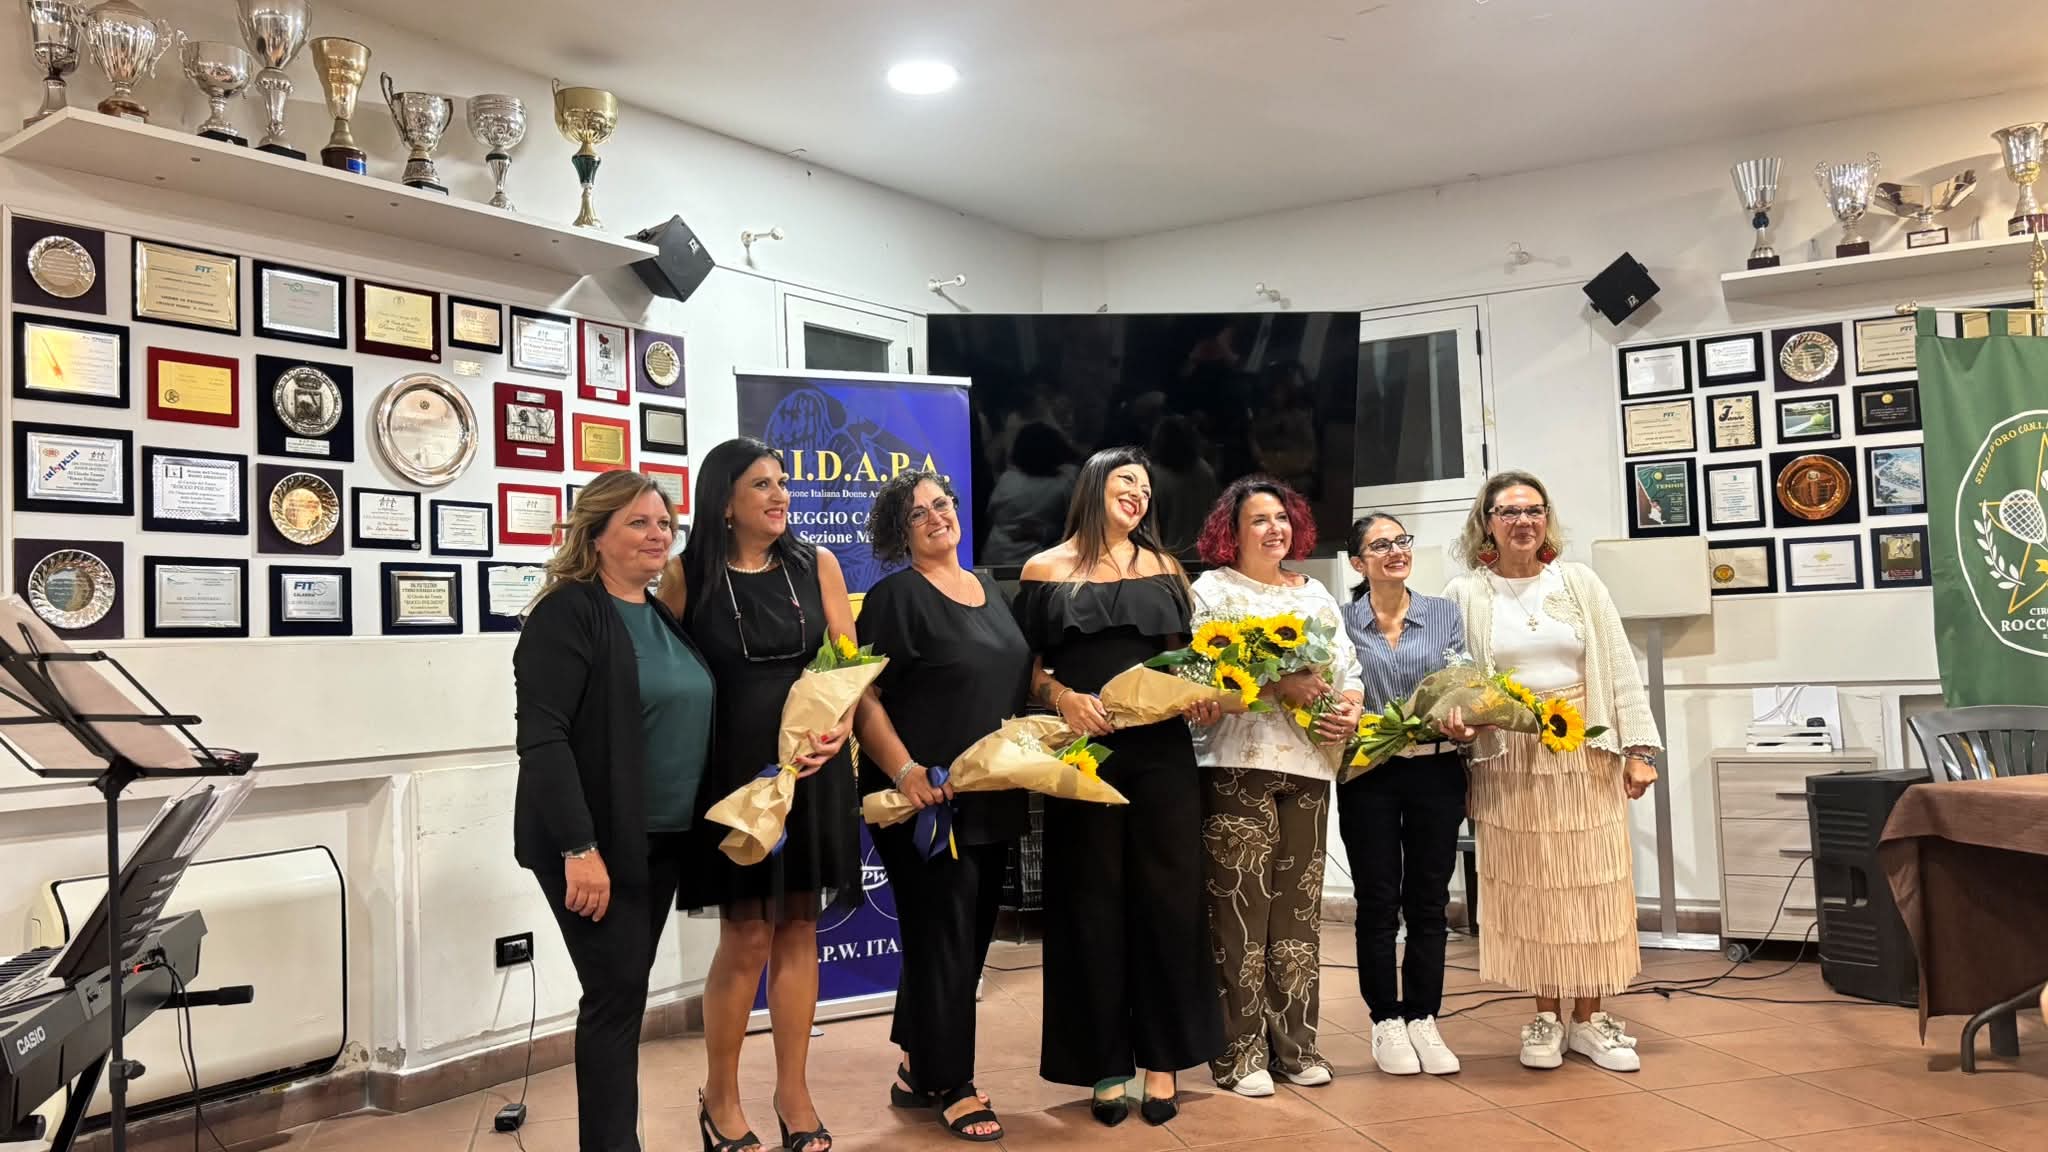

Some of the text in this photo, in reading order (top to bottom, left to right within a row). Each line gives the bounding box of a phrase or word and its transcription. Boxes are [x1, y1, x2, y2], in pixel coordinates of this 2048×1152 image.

[789, 489, 880, 498] zione Italiana Donne Ar
[786, 511, 870, 525] REGGIO CA
[800, 530, 853, 544] Sezione
[293, 581, 315, 590] FIT
[2001, 618, 2048, 632] ROCC
[861, 871, 887, 882] PW
[818, 938, 900, 962] .P.W. ITA
[16, 1026, 46, 1056] CASIO
